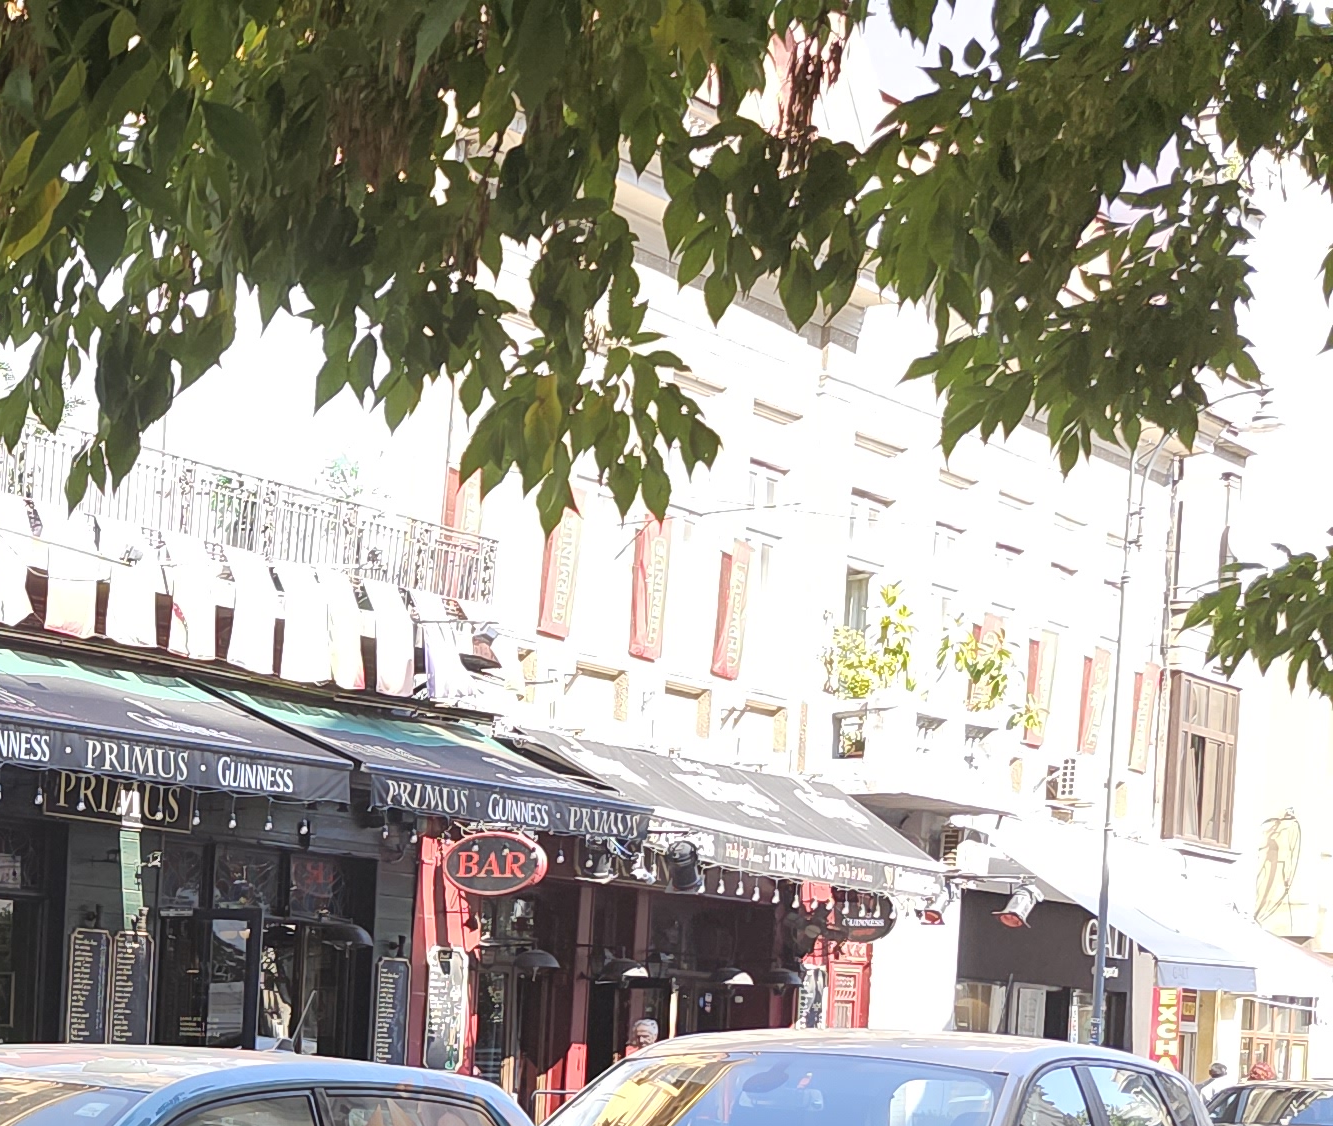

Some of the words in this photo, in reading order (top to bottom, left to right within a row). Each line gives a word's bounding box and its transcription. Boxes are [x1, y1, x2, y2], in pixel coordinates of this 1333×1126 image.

[85, 739, 189, 781] PRIMUS
[216, 756, 293, 794] GUINNESS
[56, 771, 181, 825] PRIMUS
[386, 779, 470, 815] PRIMUS
[488, 794, 549, 827] GUINNESS
[568, 806, 641, 840] PRIMUS
[456, 851, 526, 878] BAR
